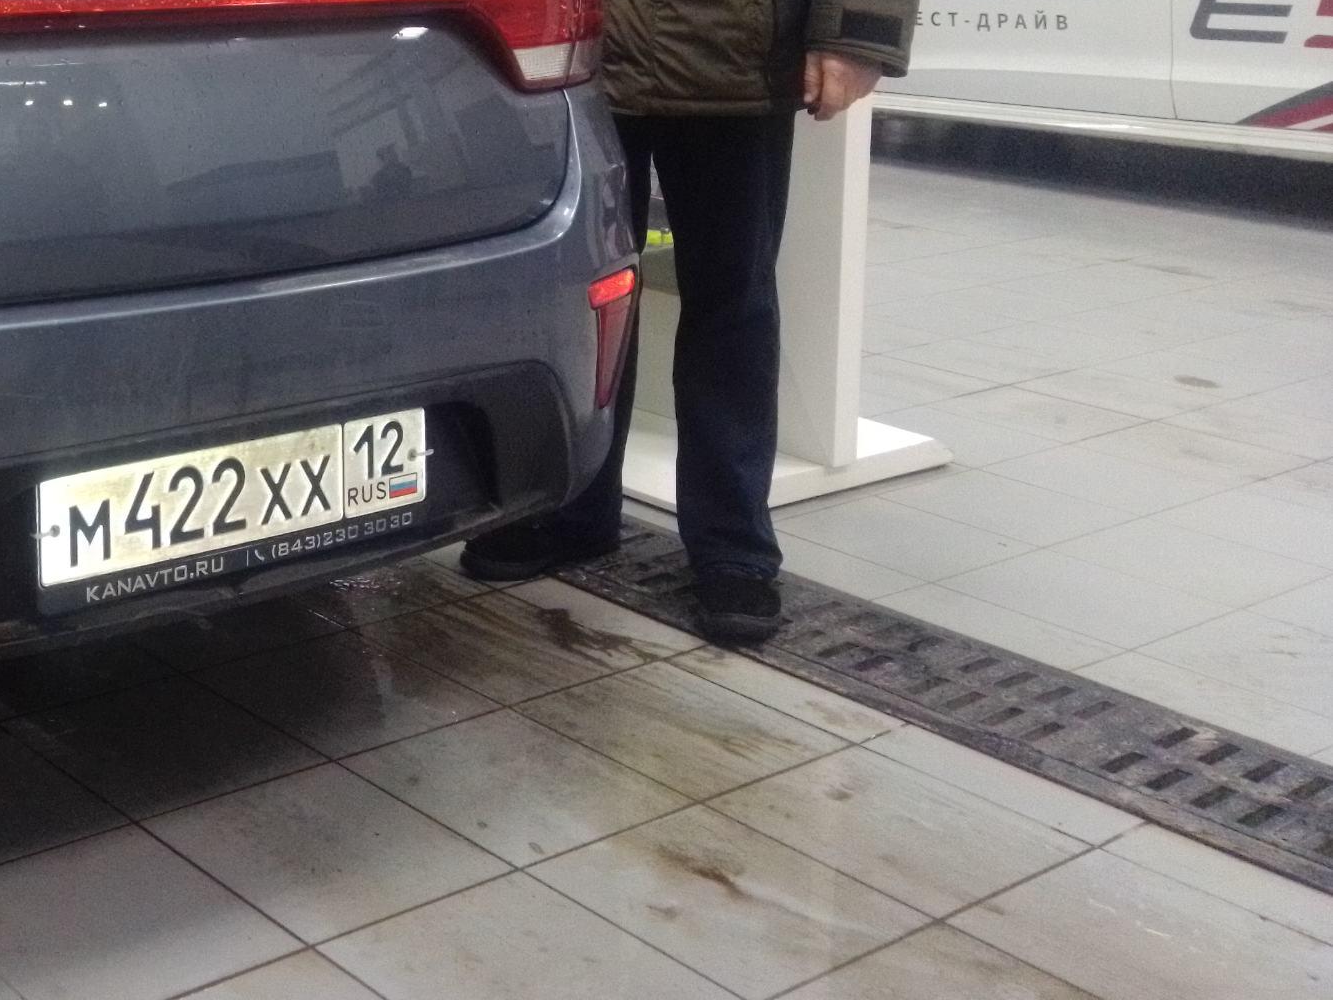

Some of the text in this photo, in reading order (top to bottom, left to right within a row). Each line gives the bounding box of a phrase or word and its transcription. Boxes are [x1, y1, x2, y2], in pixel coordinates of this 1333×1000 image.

[915, 9, 1069, 31] ЕСТ-ДРАЙВ
[352, 419, 405, 480] 12
[347, 481, 387, 508] RUS
[85, 556, 225, 603] KANAVTO.RU
